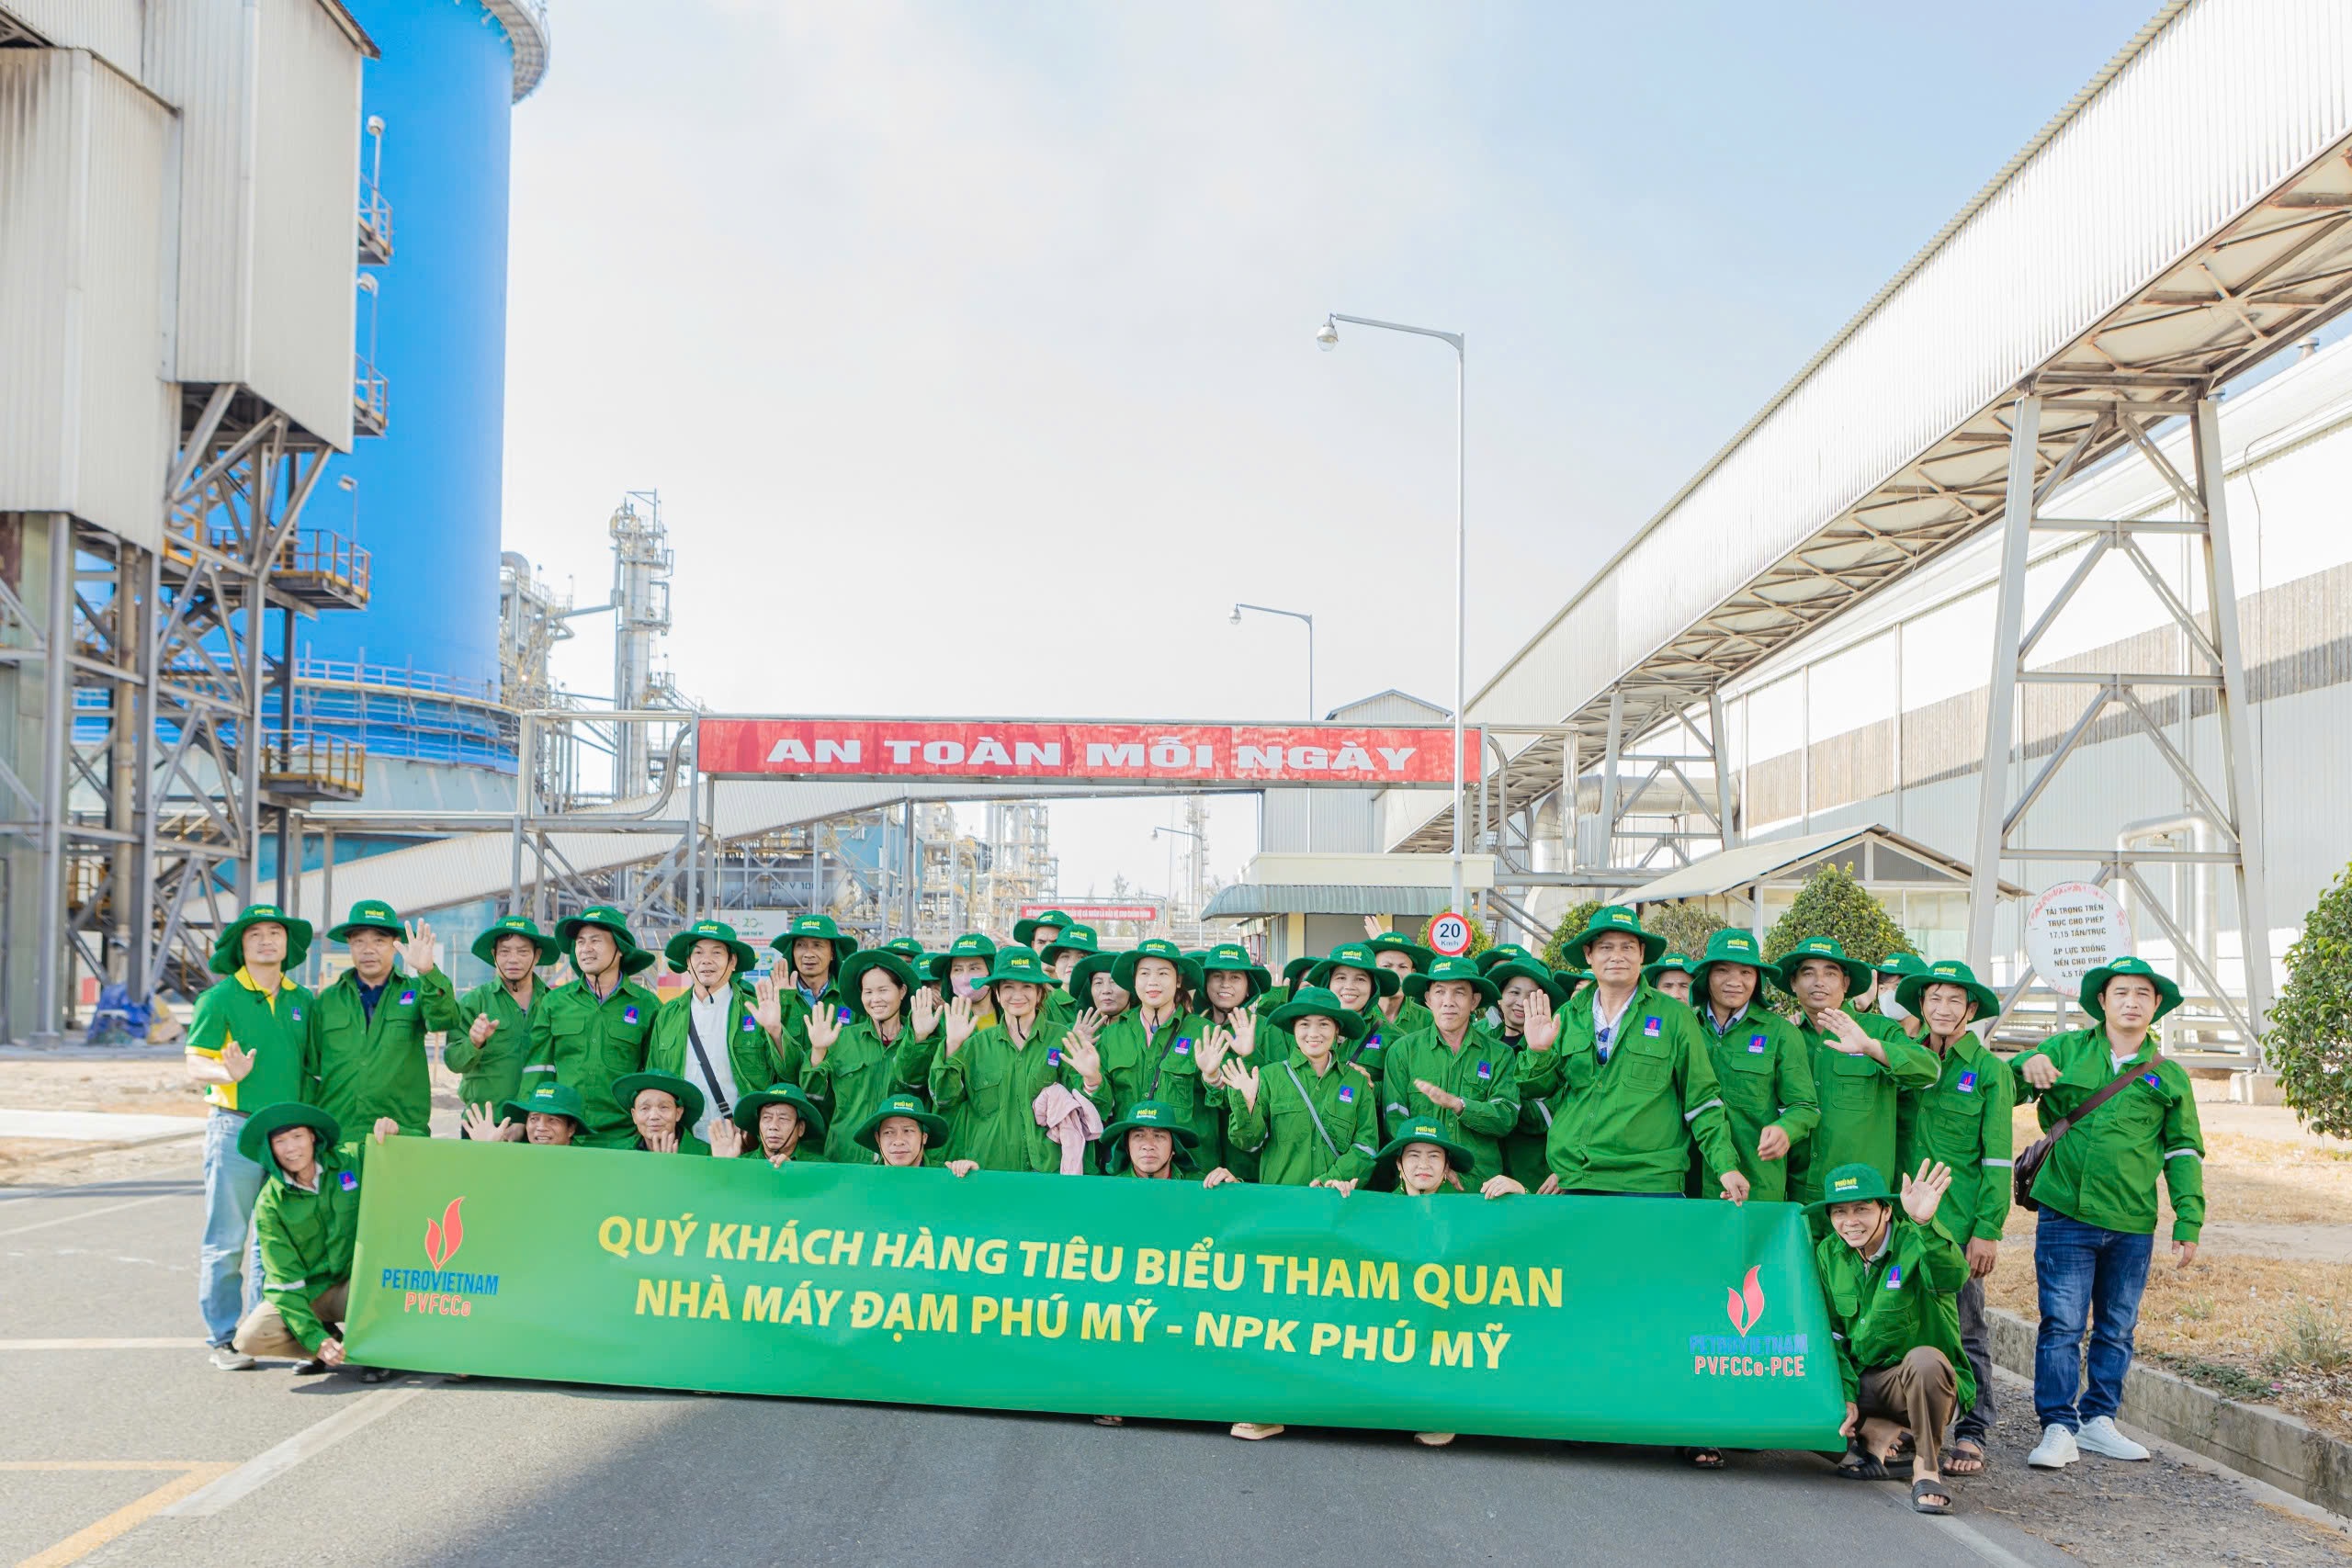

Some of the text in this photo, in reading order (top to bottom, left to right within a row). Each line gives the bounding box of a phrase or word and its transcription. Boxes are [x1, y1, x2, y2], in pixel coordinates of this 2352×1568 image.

[767, 736, 1416, 771] AN TOÀN MỖI NGÀY
[2046, 904, 2104, 916] TẢI TRỌNG TRÊN
[1440, 923, 1461, 938] 20
[2048, 916, 2105, 929] TRỤC CHO PHÉP
[2053, 943, 2107, 955] ÁP LỰC XUỐNG
[2071, 958, 2086, 966] CHO
[2087, 955, 2108, 964] PHÉP
[1426, 1126, 1436, 1134] MỸ
[1846, 1177, 1857, 1185] MỸ
[598, 1213, 1563, 1310] QUÝ KHÁCH HÀNG TIÊU BIỂU THAM QUAN
[381, 1268, 499, 1295] PETROVIETNAM
[404, 1292, 471, 1317] PVFCCo
[635, 1274, 1511, 1370] NHÀ MÁY ĐẠM PHÚ MỸ - NPK PHÚ MỸ
[1690, 1334, 1808, 1355] PETROVIETNAM
[1694, 1355, 1806, 1377] PVFCCo-PCE
